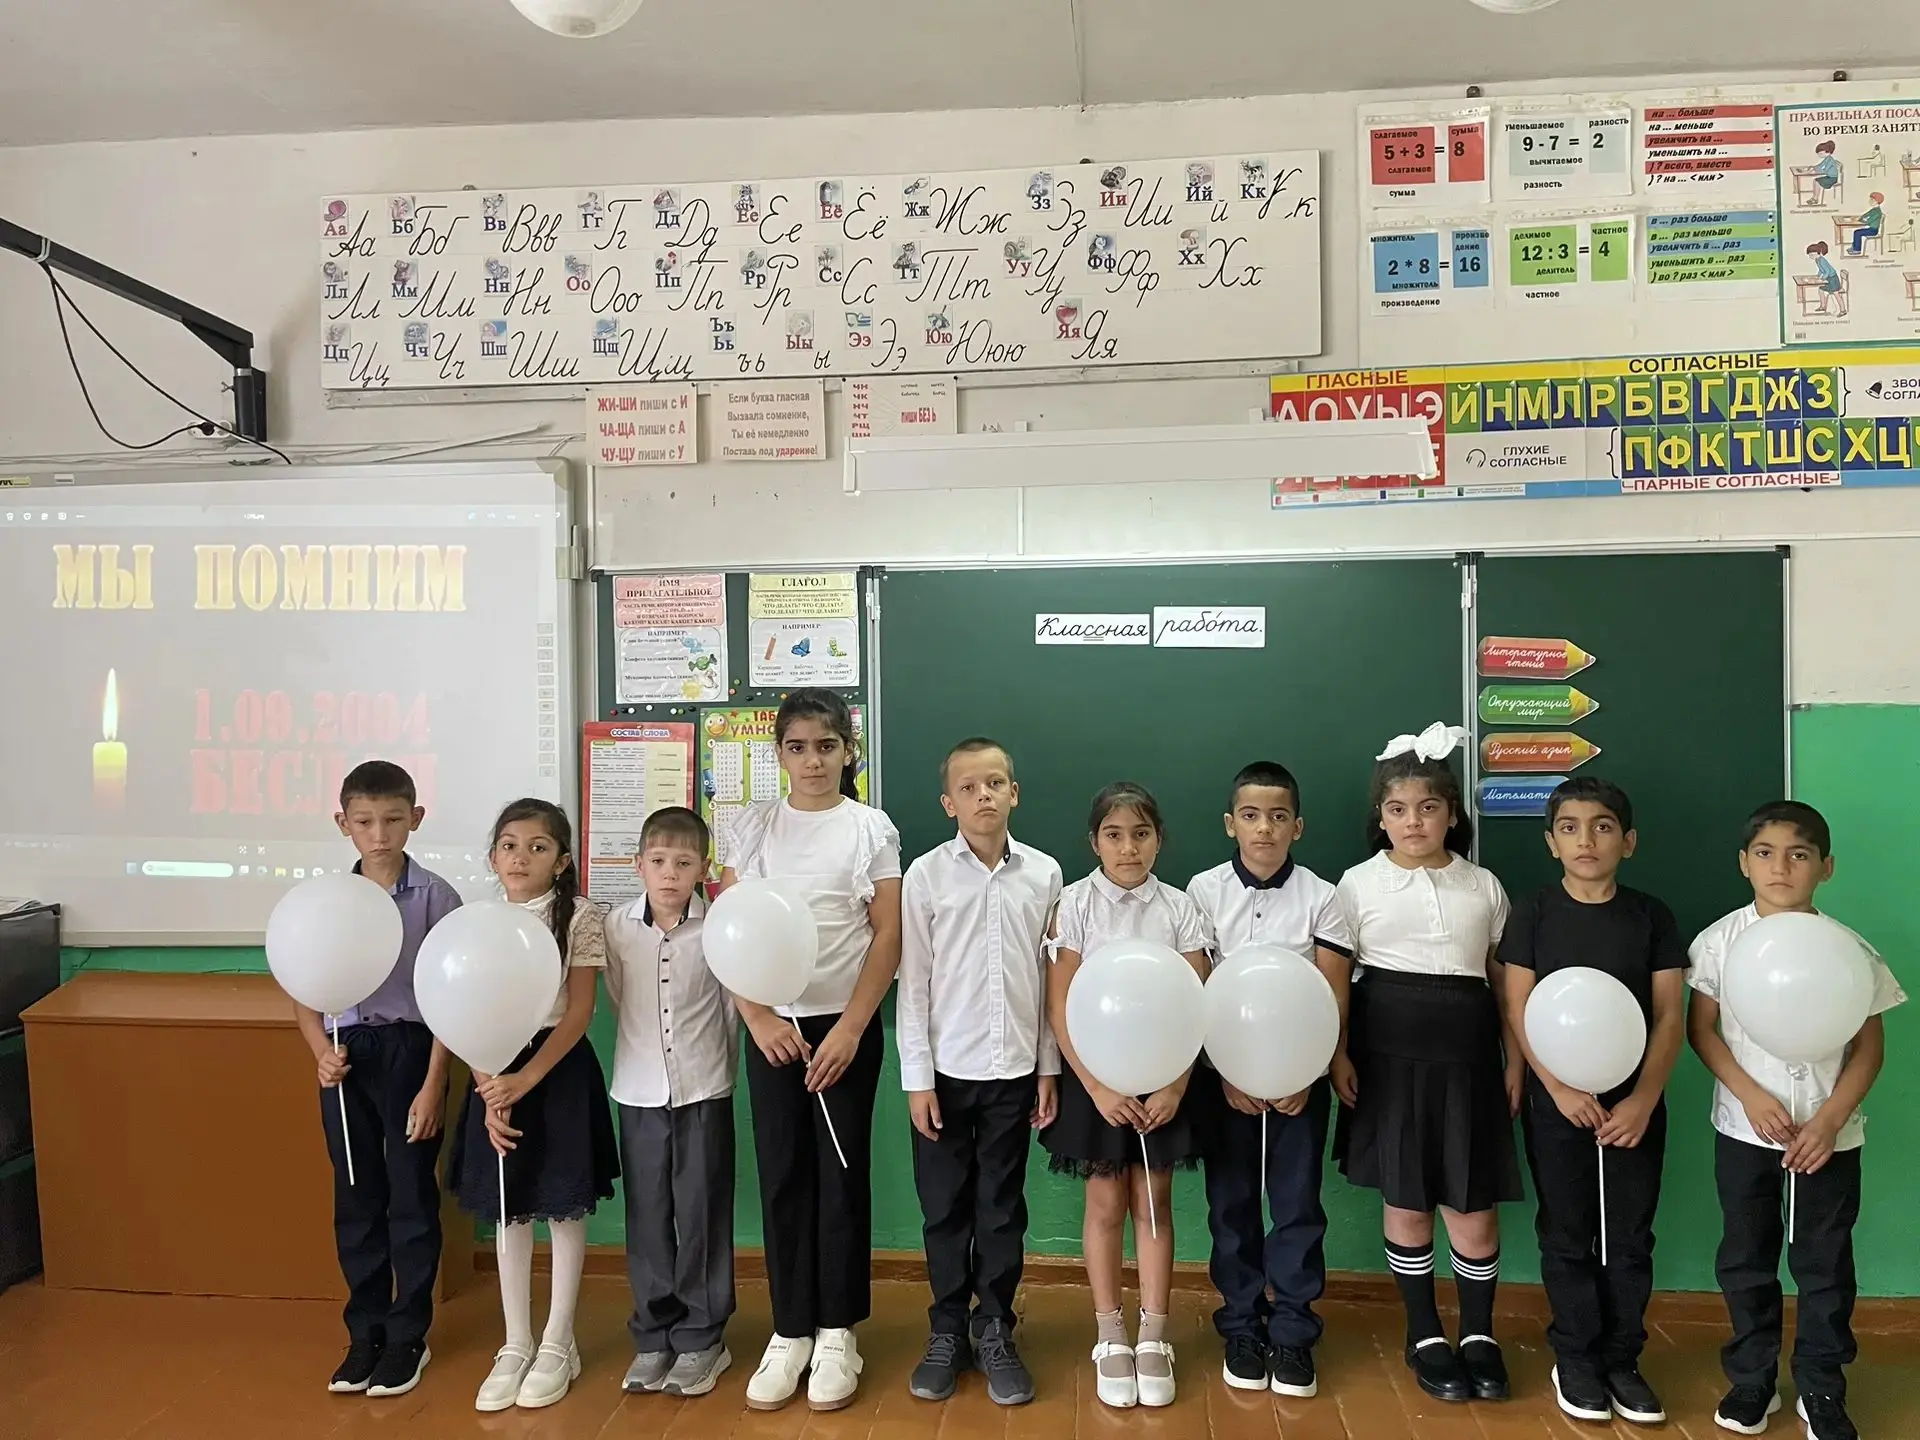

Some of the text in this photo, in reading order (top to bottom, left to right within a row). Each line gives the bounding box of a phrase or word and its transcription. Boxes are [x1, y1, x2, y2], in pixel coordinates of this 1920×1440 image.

[1651, 108, 1715, 118] на больше
[1789, 108, 1882, 122] ПРАВИЛЬНАЯ
[1504, 121, 1564, 132] уменьшаемое
[1588, 117, 1630, 128] разность
[1674, 121, 1714, 130] меньше
[1374, 130, 1418, 139] слагаемое
[1451, 126, 1480, 136] сумма
[1803, 122, 1920, 136] ВО ВРЕМЯ ЗАНЯТ
[1522, 132, 1604, 152] 9 7 2
[1648, 136, 1698, 147] увеличить
[1384, 141, 1464, 161] 5 3 8
[1647, 148, 1703, 160] уменьшить
[1529, 156, 1583, 166] вычитаемое
[1696, 160, 1732, 169] вместе
[1388, 165, 1432, 174] слагаемое
[1698, 174, 1715, 182] или
[1523, 180, 1563, 190] разность
[1388, 188, 1416, 198] сумма
[324, 222, 348, 237] Аа
[392, 219, 414, 235] Бб
[484, 216, 507, 232] Вв
[582, 214, 604, 230] Гг
[654, 212, 680, 229] Дд
[820, 200, 844, 219] Ёё
[904, 202, 930, 218] Жж
[1100, 191, 1128, 207] Ии
[1240, 183, 1266, 200] Кк
[1670, 214, 1728, 226] раз больше
[1455, 230, 1490, 240] произве
[1514, 230, 1552, 242] делимое
[1592, 225, 1628, 235] частное
[1672, 228, 1732, 240] раз меньше
[1370, 234, 1416, 244] множитель
[1454, 242, 1480, 252] дение
[1521, 240, 1610, 262] 12 3 4
[1650, 242, 1701, 253] увеличить
[1388, 256, 1481, 276] 2 8 16
[1649, 256, 1706, 269] уменьшить
[324, 284, 348, 299] Лл
[392, 284, 418, 298] Мм
[566, 276, 592, 292] Оо
[744, 270, 766, 288] Рр
[898, 265, 920, 280] Тт
[1086, 256, 1117, 274] Фф
[1536, 266, 1576, 277] делитель
[1708, 270, 1726, 278] или
[1392, 281, 1439, 290] множитель
[1525, 290, 1560, 299] частное
[1380, 298, 1441, 308] произведение
[324, 344, 350, 362] Цц
[480, 342, 508, 356] Шш
[786, 336, 814, 350] Ыы
[1057, 324, 1082, 340] Яя
[1628, 352, 1769, 372] СОГЛАСНЫЕ
[1306, 370, 1408, 390] ГЛАСНЫЕ
[1892, 378, 1920, 389] ЗВО
[728, 392, 810, 404] Если буква гласная
[852, 392, 868, 400] ЧК
[598, 395, 688, 412] ЖИ-ШИ пиши с И
[852, 402, 869, 410] НЧ
[853, 412, 869, 420] ЧТ
[918, 407, 932, 424] БЕЗ
[599, 420, 686, 440] ЧА-ЩА пиши с А
[732, 428, 744, 439] Ты
[757, 428, 810, 440] немедленно
[601, 444, 685, 464] ЧУ-ЩУ пиши с У
[758, 446, 774, 458] под
[774, 444, 818, 458] ударение!
[1503, 444, 1550, 456] ГЛУХИЕ
[1488, 452, 1568, 468] СОГЛАСНЫЕ
[1634, 472, 1830, 491] ПАРНЫЕ СОГЛАСНЫЕ
[52, 543, 468, 612] МЫ ПОМНИМ
[782, 577, 828, 588] ГЛАГОЛ
[626, 588, 713, 598] ПРИЛАГАТЕЛЬНОЕ
[1038, 616, 1148, 637] Классная
[1483, 644, 1568, 660] Литературное
[1504, 660, 1545, 669] чтение
[1488, 694, 1571, 712] Окружающий
[1517, 708, 1544, 720] мир
[644, 729, 669, 737] СЛОВА
[1488, 740, 1573, 760] Русский язык
